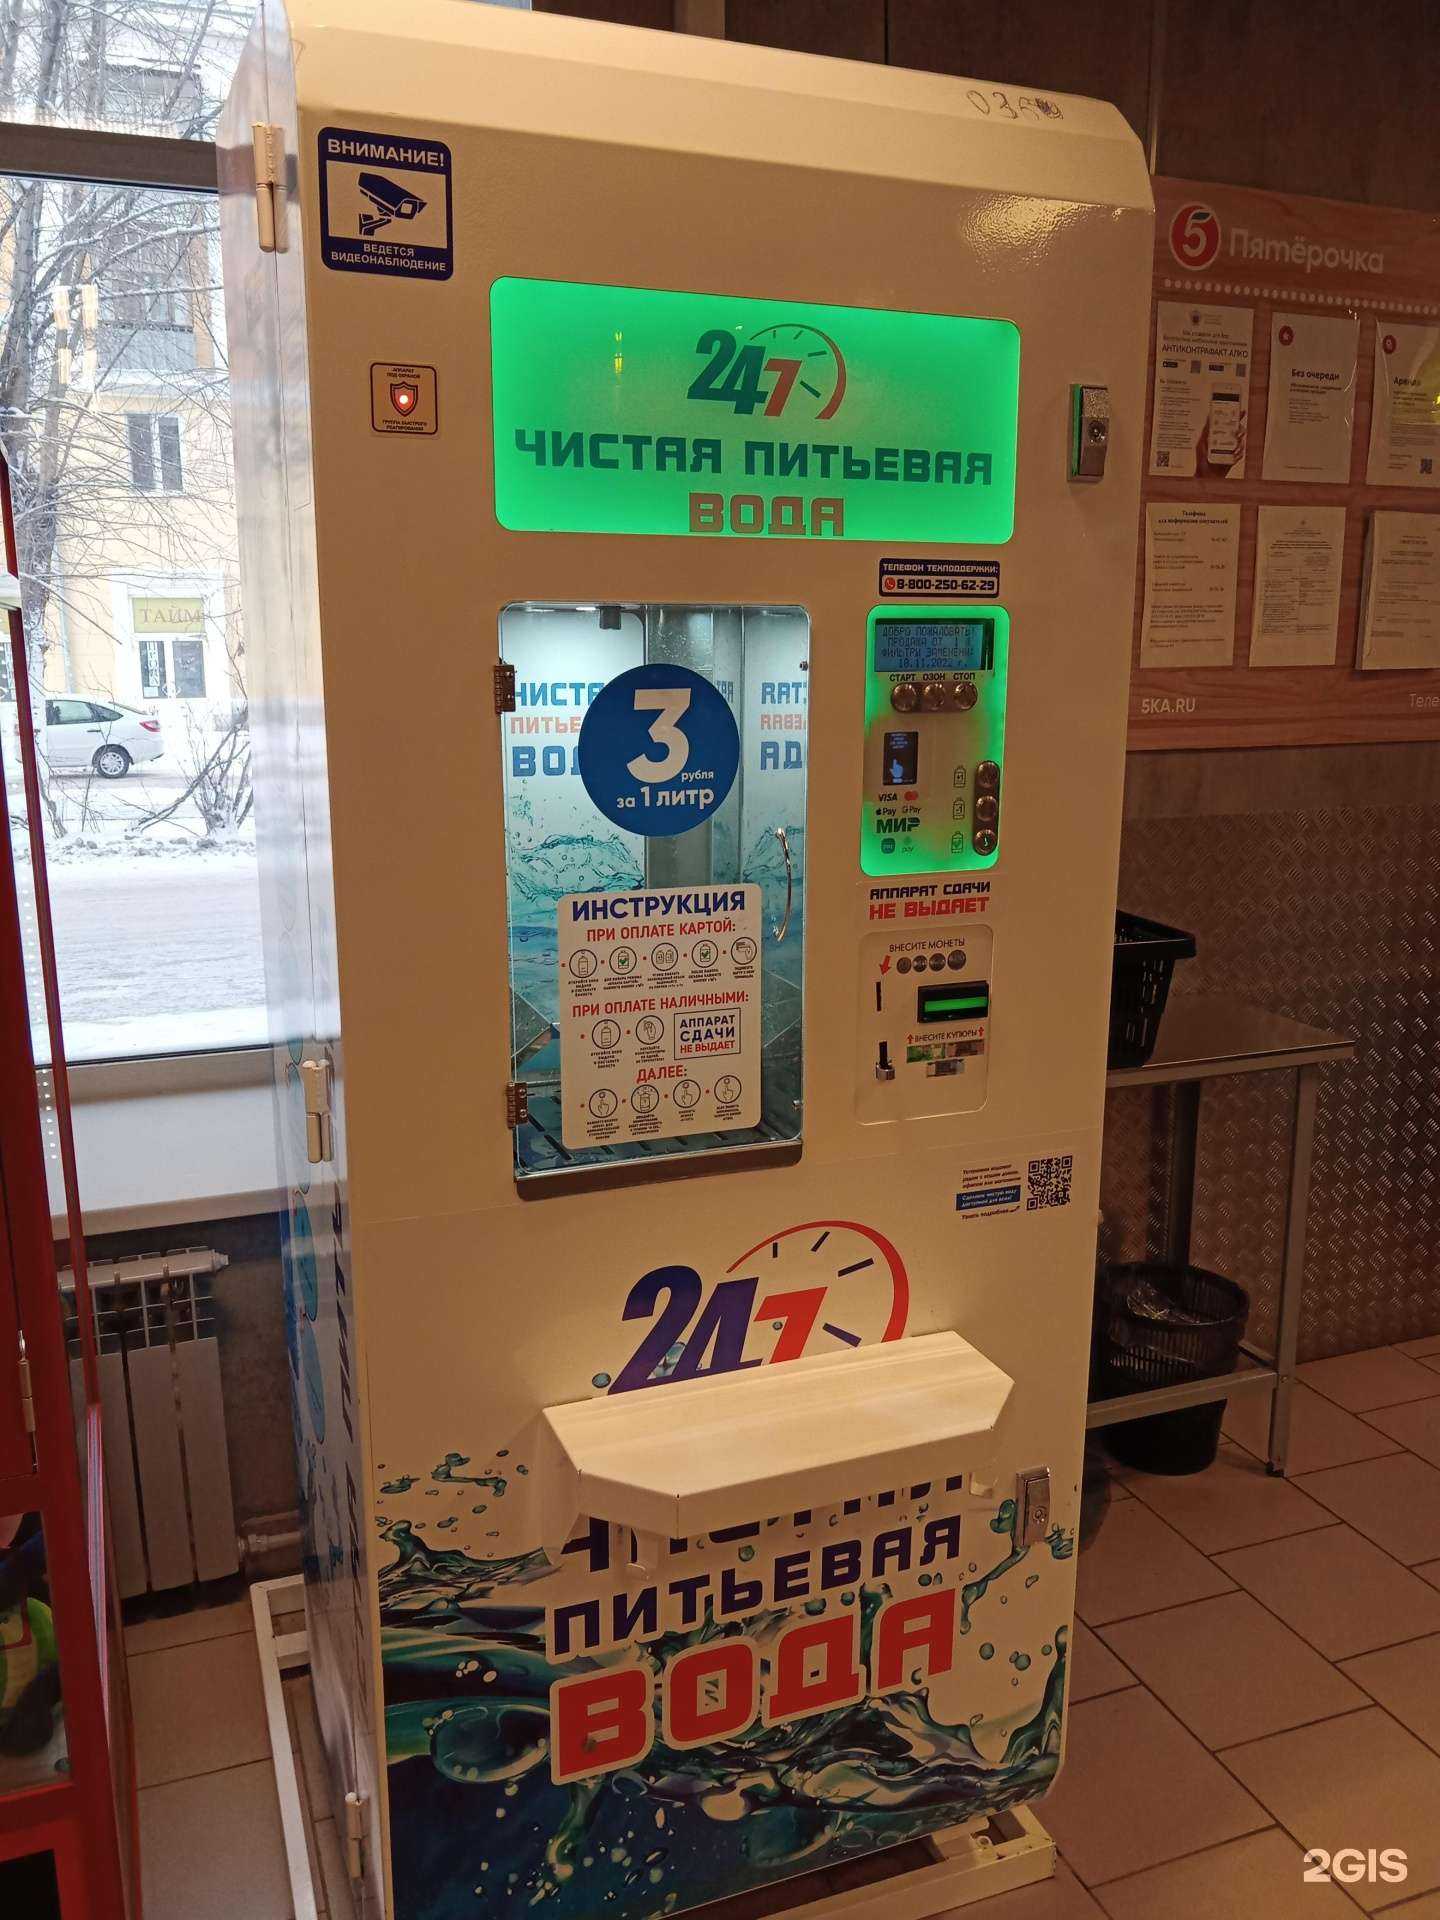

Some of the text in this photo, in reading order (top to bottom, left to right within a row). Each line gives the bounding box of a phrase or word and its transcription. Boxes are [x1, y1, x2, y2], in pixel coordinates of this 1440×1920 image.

[327, 138, 445, 167] ВНИМАНИЕ!
[363, 243, 415, 257] ВЕДЕТСЯ
[1229, 227, 1385, 274] Пятёрочка
[331, 251, 447, 272] ВИДЕОНАБЛЮДЕНИЕ
[1291, 368, 1340, 381] Без очереди
[515, 429, 993, 486] ЧИСТАЯ ПИТЬЕВАЯ
[689, 492, 845, 537] ВОДА
[883, 563, 998, 574] ТЕЛЕФОН ТЕХПОДДЕРЖКИ:
[897, 578, 995, 591] 8-800-250-62-29
[889, 672, 976, 682] СТАРТ ОЗОН СТОП
[626, 687, 692, 784] 3
[681, 769, 714, 782] рубля
[616, 786, 715, 810] за 1 литр
[878, 792, 898, 802] VISA
[882, 807, 897, 817] Pay
[876, 817, 920, 834] МИР
[870, 881, 991, 900] АППАРАТ СДАЧИ
[572, 890, 745, 922] ИНСТРУКЦИЯ
[869, 896, 990, 920] НЕ ВЫДАЕТ
[587, 917, 736, 943] ПРИ ОПЛАТЕ КАРТОЙ:
[889, 938, 965, 953] ВНЕСИТЕ МОНЕТЫ
[572, 991, 749, 1018] ПРИ ОПЛАТЕ НАЛИЧНЫМИ:
[679, 1014, 736, 1029] АППАРАТ
[679, 1026, 735, 1043] СДАЧИ
[914, 1029, 977, 1043] ВНЕСИТЕ КУПЮРЫ
[679, 1039, 736, 1054] НЕ ВЫДАЕТ
[636, 1064, 688, 1084] ДАЛЕЕ:
[553, 1515, 961, 1656] ПИТЬЕВАЯ
[558, 1587, 956, 1778] ВОДА
